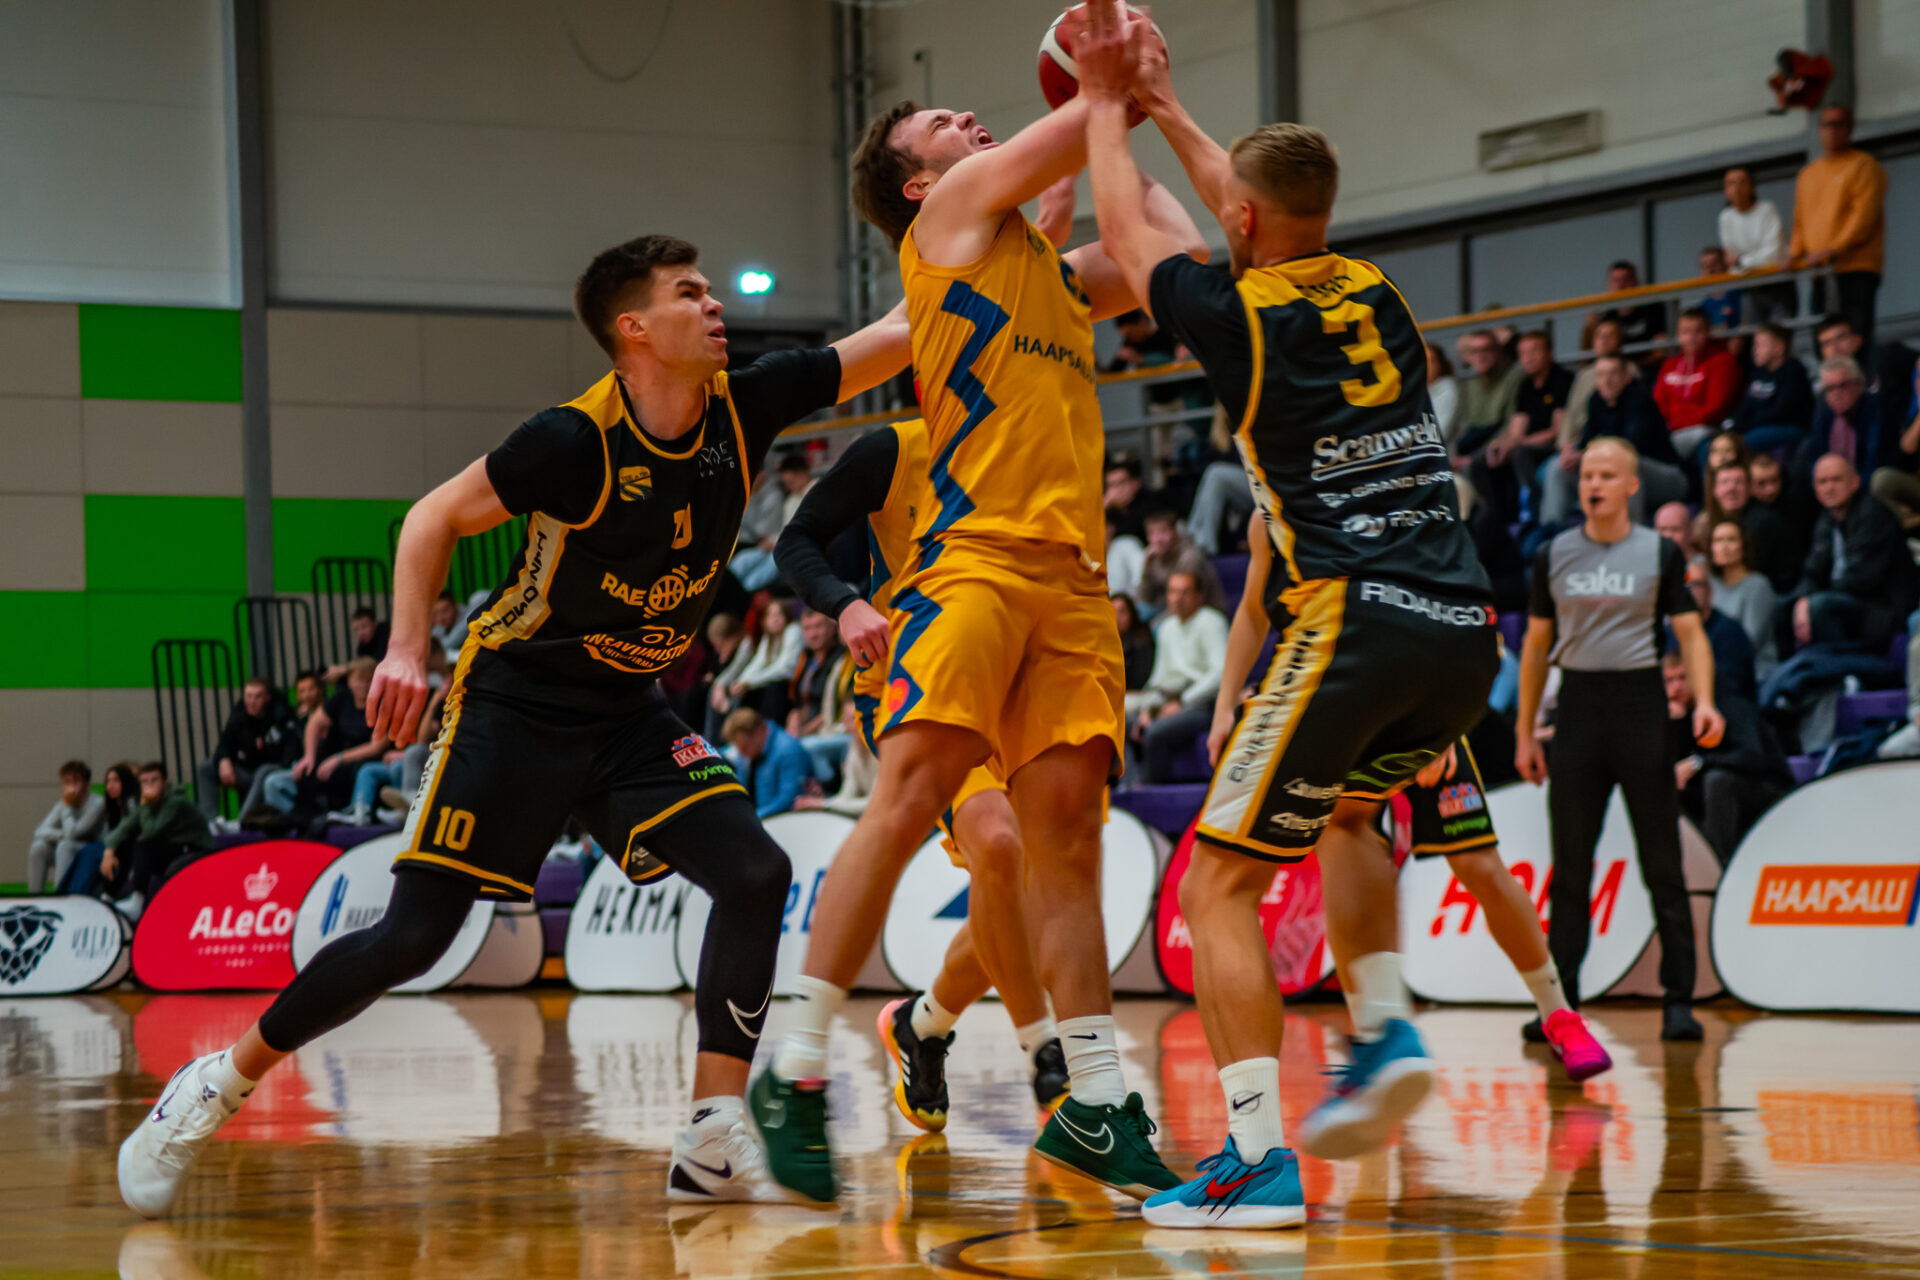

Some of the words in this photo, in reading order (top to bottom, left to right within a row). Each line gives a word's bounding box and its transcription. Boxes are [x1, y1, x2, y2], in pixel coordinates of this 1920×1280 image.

[1320, 300, 1401, 408] 3
[600, 572, 647, 606] RAE
[1565, 564, 1635, 596] saku
[433, 806, 476, 852] 10
[1762, 879, 1909, 913] HAAPSALU
[188, 901, 297, 940] A.LeCo
